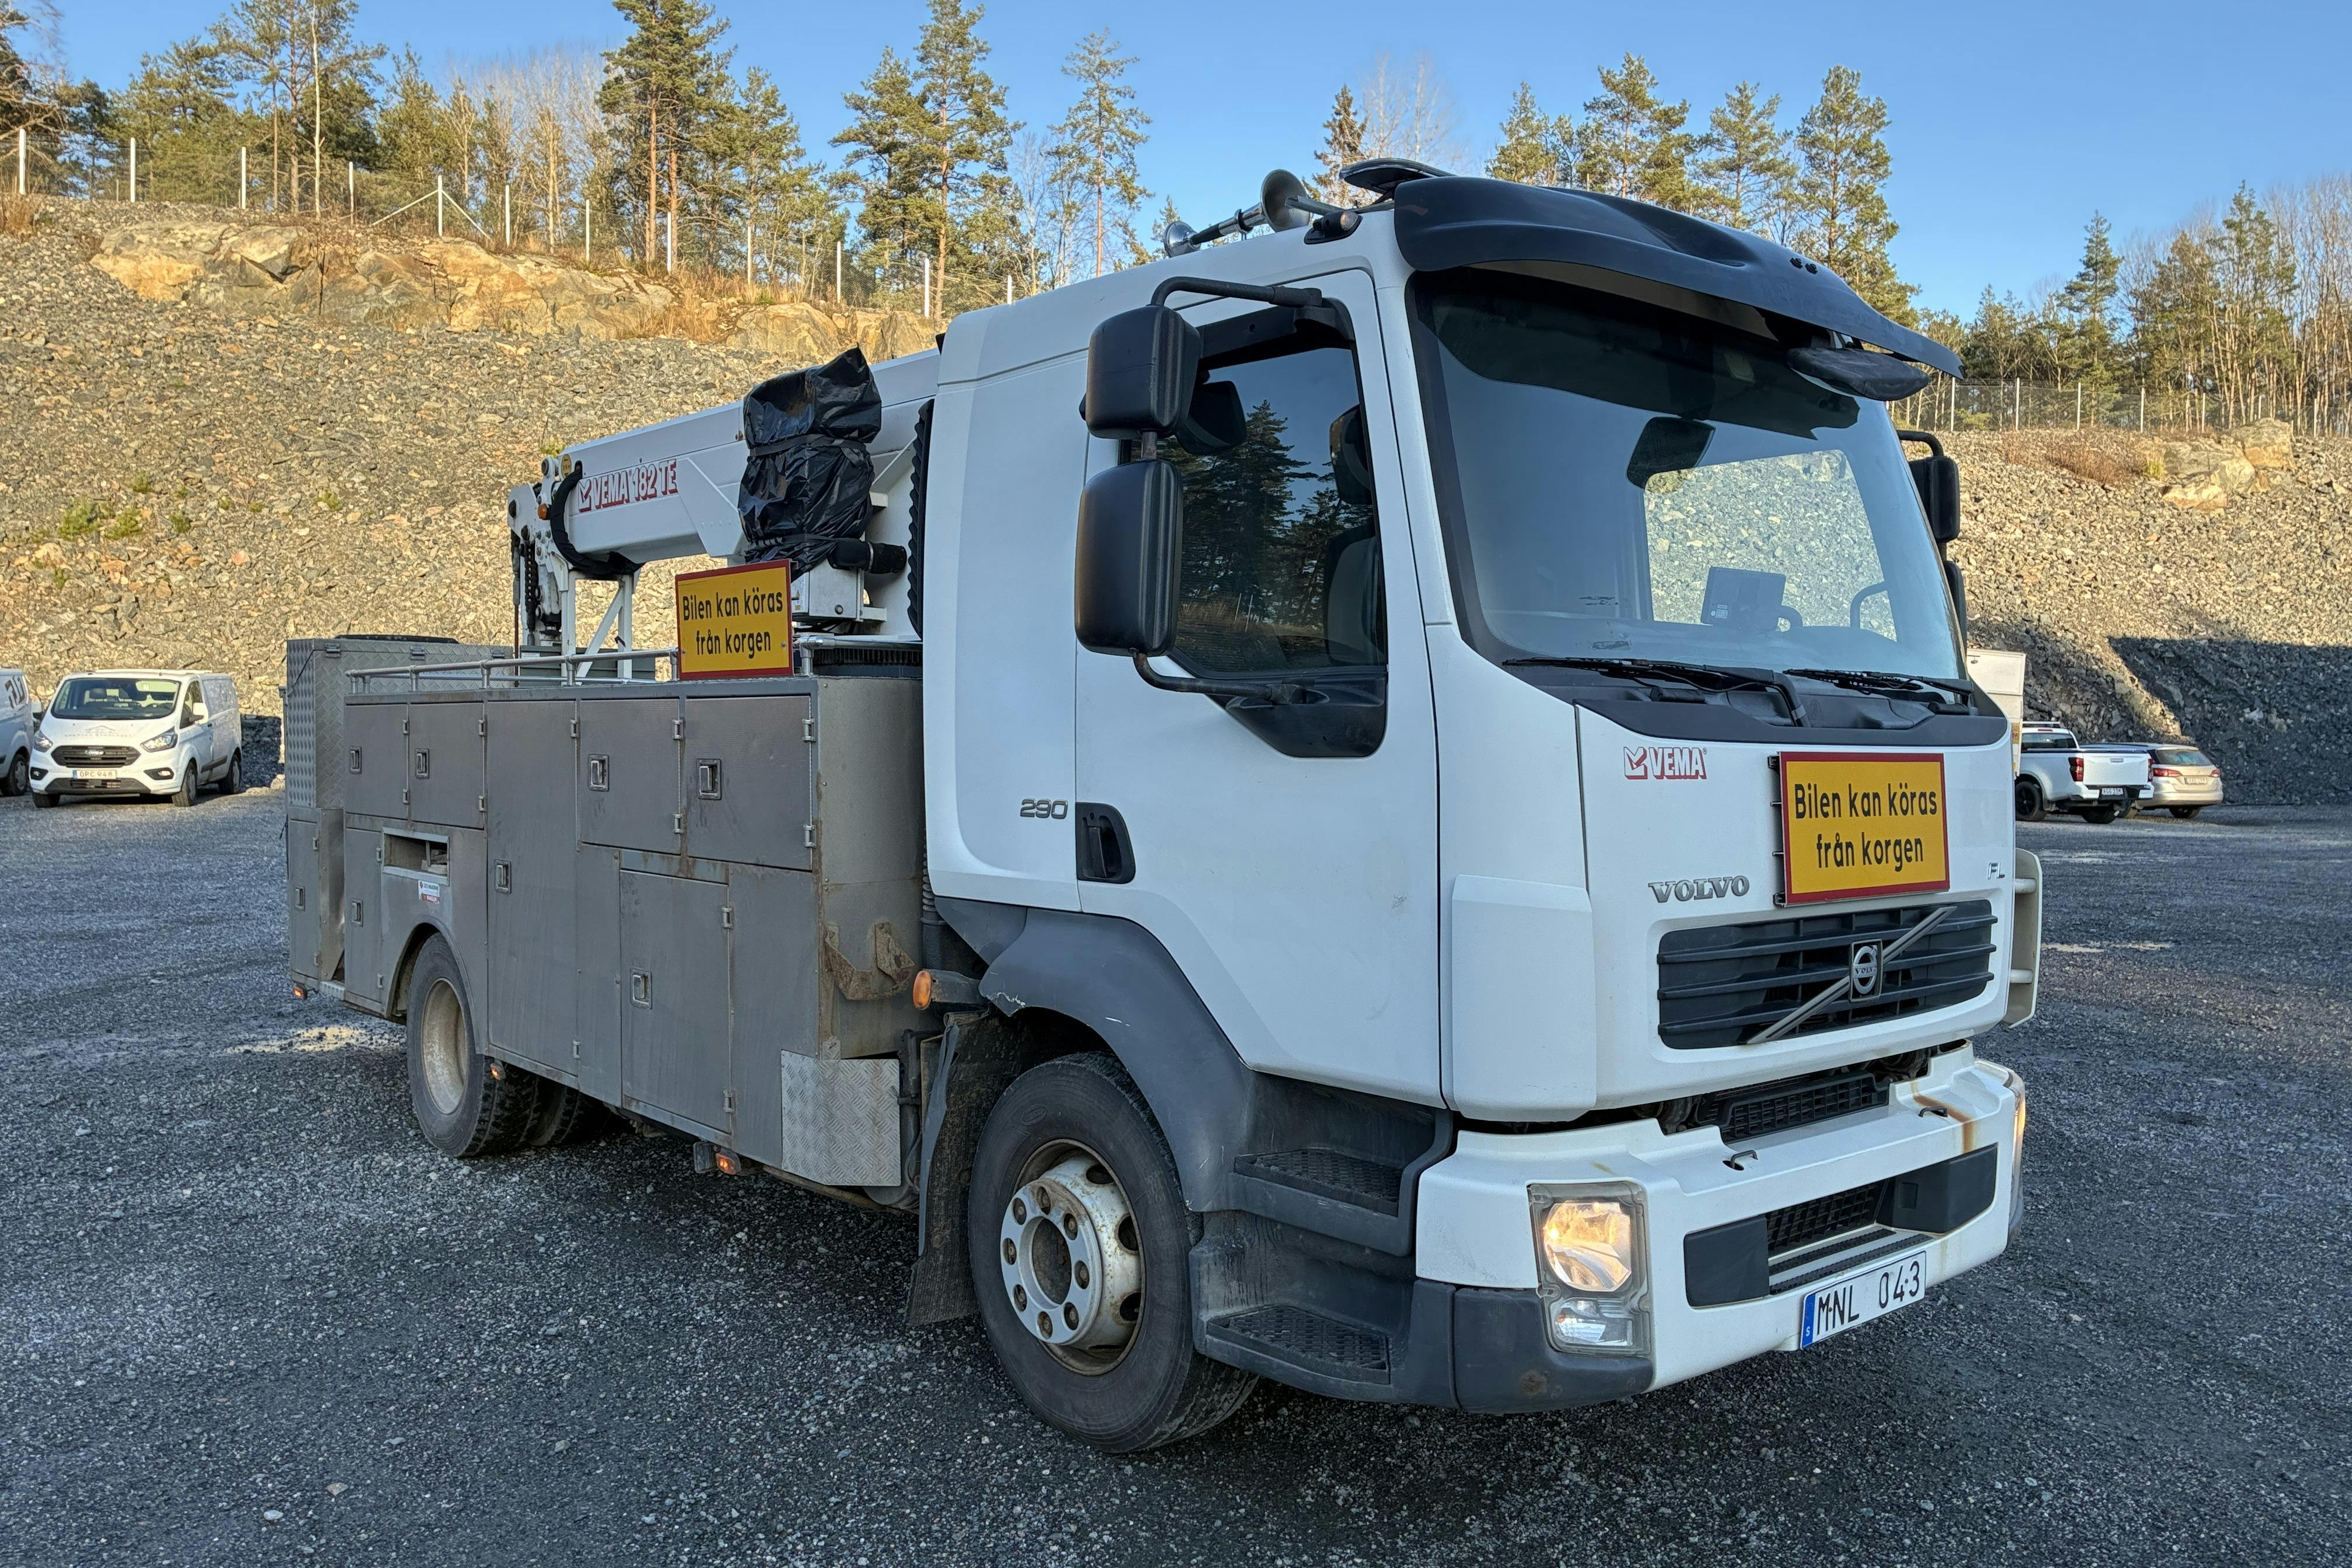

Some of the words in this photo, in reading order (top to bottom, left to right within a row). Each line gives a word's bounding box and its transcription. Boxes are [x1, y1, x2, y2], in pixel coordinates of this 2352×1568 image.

[593, 470, 630, 509] VEMA
[632, 464, 657, 501] 182
[659, 459, 678, 495] TE
[683, 594, 712, 621] Bilen
[716, 592, 739, 617] kan
[744, 587, 783, 614] köras
[696, 629, 720, 655] från
[725, 628, 771, 659] korgen
[1648, 747, 1707, 779] VEMA
[1020, 797, 1069, 820] 290
[1795, 783, 1842, 819] Bilen
[1848, 783, 1882, 817] kan
[1888, 782, 1937, 816] köras
[1817, 832, 1855, 869] från
[1861, 832, 1924, 873] korgen
[1988, 862, 2005, 880] FL
[1648, 875, 1749, 903] VOLVO
[1817, 1284, 1860, 1335] MNL
[1879, 1260, 1919, 1309] 043
[1805, 1326, 1811, 1337] S
